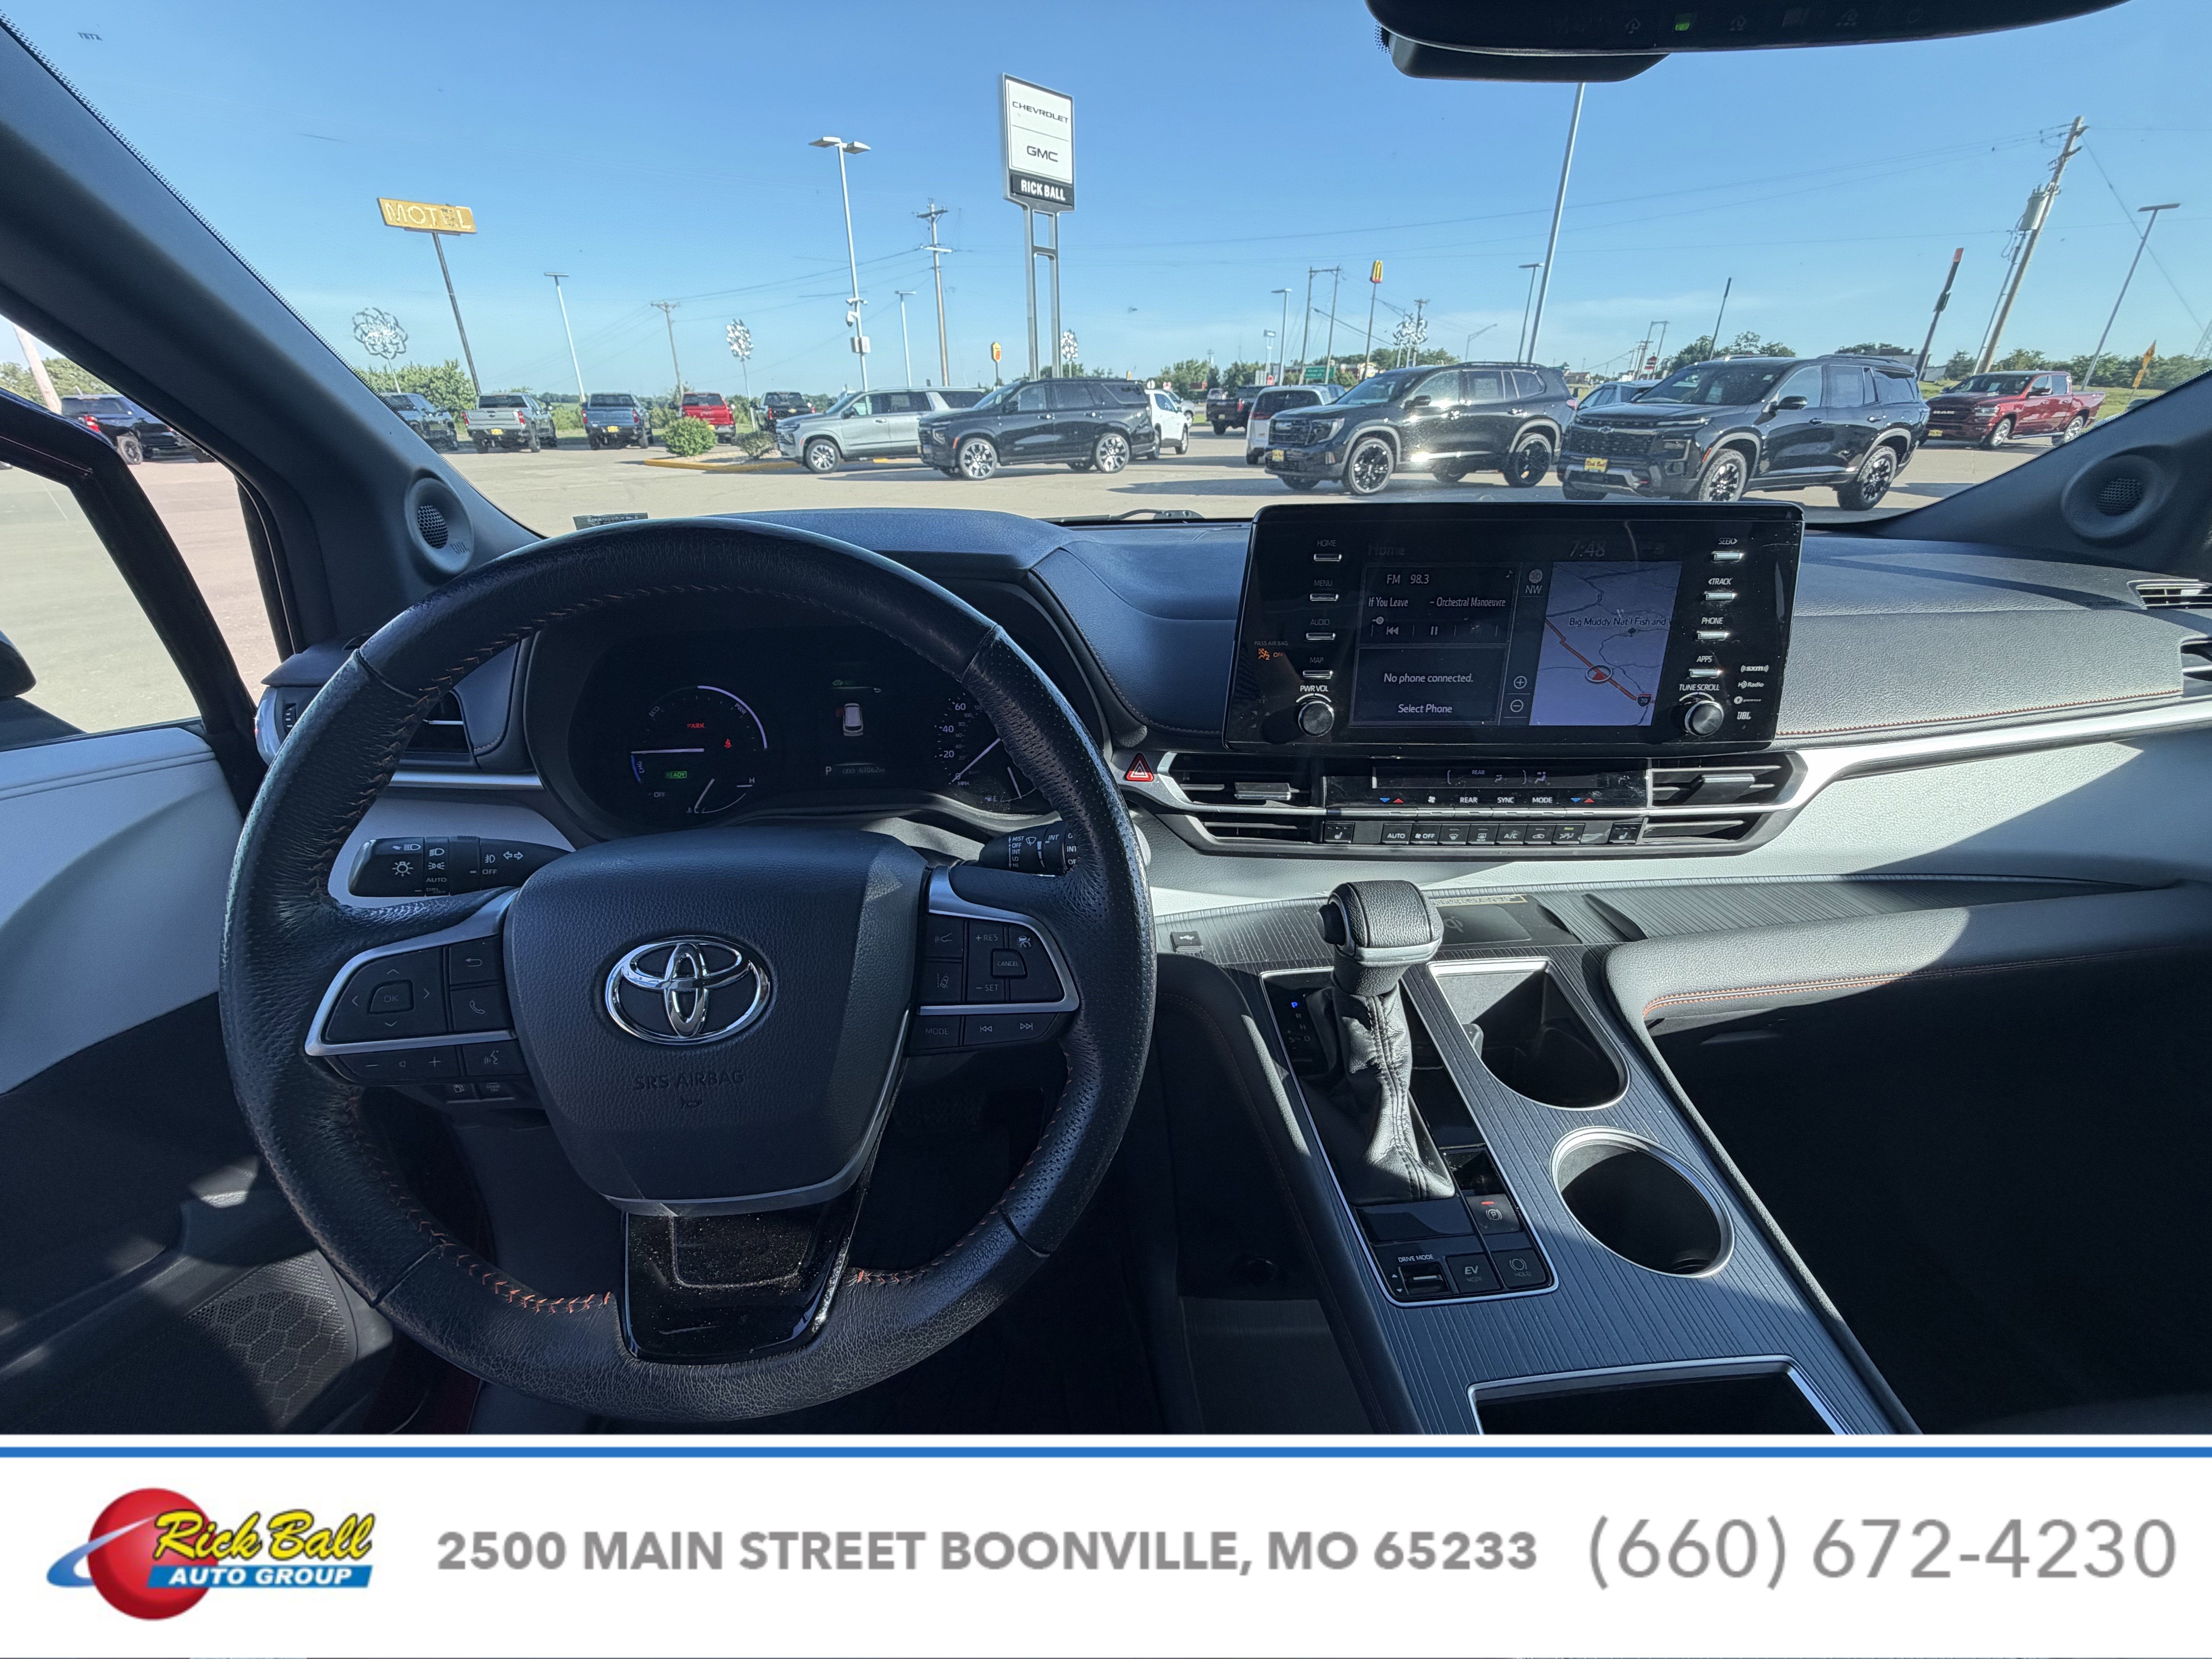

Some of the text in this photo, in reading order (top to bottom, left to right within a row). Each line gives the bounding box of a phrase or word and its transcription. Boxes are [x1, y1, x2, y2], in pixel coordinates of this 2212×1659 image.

[1012, 101, 1068, 124] CHEVROLET
[1027, 145, 1058, 162] GMC
[1021, 179, 1066, 201] RICK BALL
[1368, 544, 1405, 556] Home
[1569, 541, 1606, 557] 7:48
[1386, 574, 1429, 584] FM 98.3
[1525, 585, 1542, 594] NW
[1369, 597, 1408, 607] If You Leave
[1436, 596, 1469, 607] Orchestral
[1471, 597, 1506, 607] Manoeuvre
[1570, 617, 1582, 627] Big
[1583, 617, 1611, 627] Muddy
[1634, 617, 1650, 625] Fish
[1651, 617, 1666, 625] and
[1384, 673, 1474, 684] No phone connected.
[649, 706, 660, 717] ECO
[734, 703, 747, 714] PWR
[1398, 704, 1453, 713] Select Phone
[1737, 711, 1751, 720] JBL
[636, 761, 644, 774] CHG
[826, 766, 831, 775] P
[383, 994, 398, 1003] OK
[925, 1027, 948, 1035] MODE
[635, 1070, 745, 1092] SRS AIRBAG
[1465, 1266, 1479, 1274] EV
